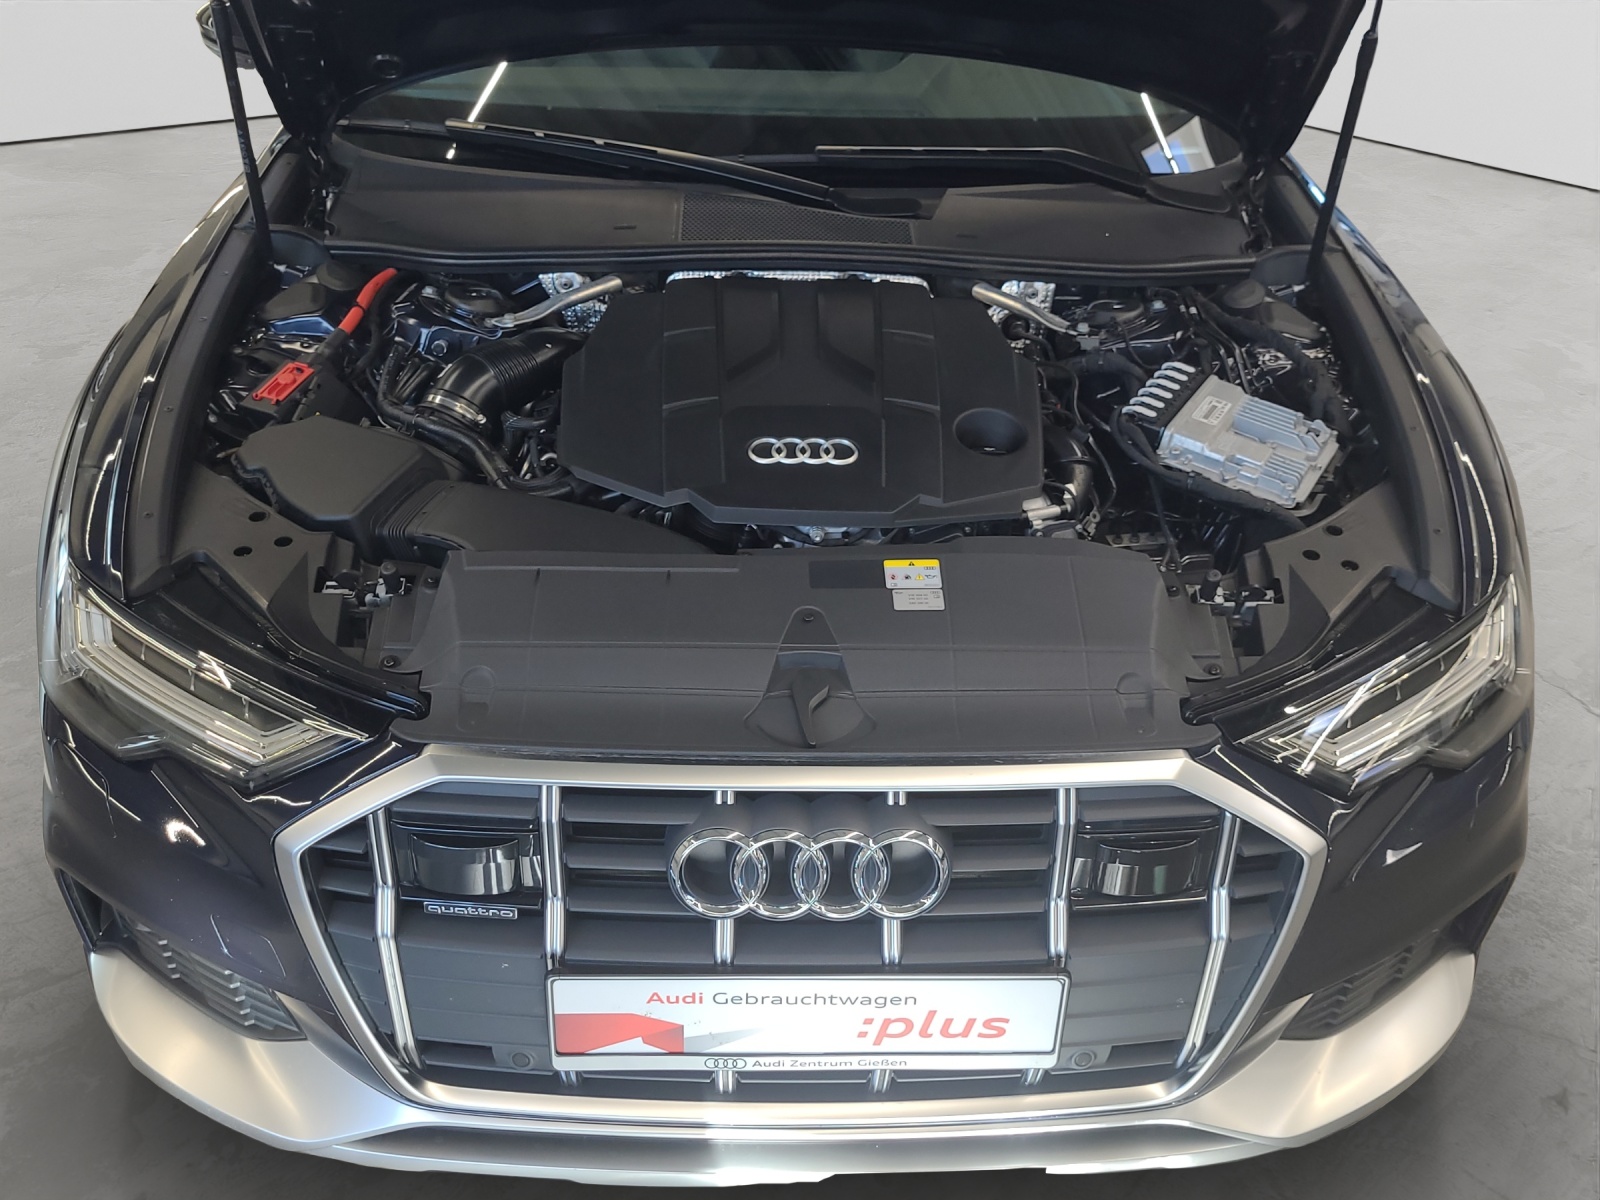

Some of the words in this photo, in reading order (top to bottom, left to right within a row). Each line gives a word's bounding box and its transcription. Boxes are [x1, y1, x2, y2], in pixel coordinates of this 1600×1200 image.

[427, 905, 514, 917] quattro
[647, 991, 704, 1005] Audi
[712, 991, 918, 1009] Gebrauchtwagen
[857, 1010, 1010, 1046] :plus
[751, 1059, 786, 1068] Audi
[789, 1059, 853, 1068] Zentrum
[857, 1058, 908, 1067] Gießen
